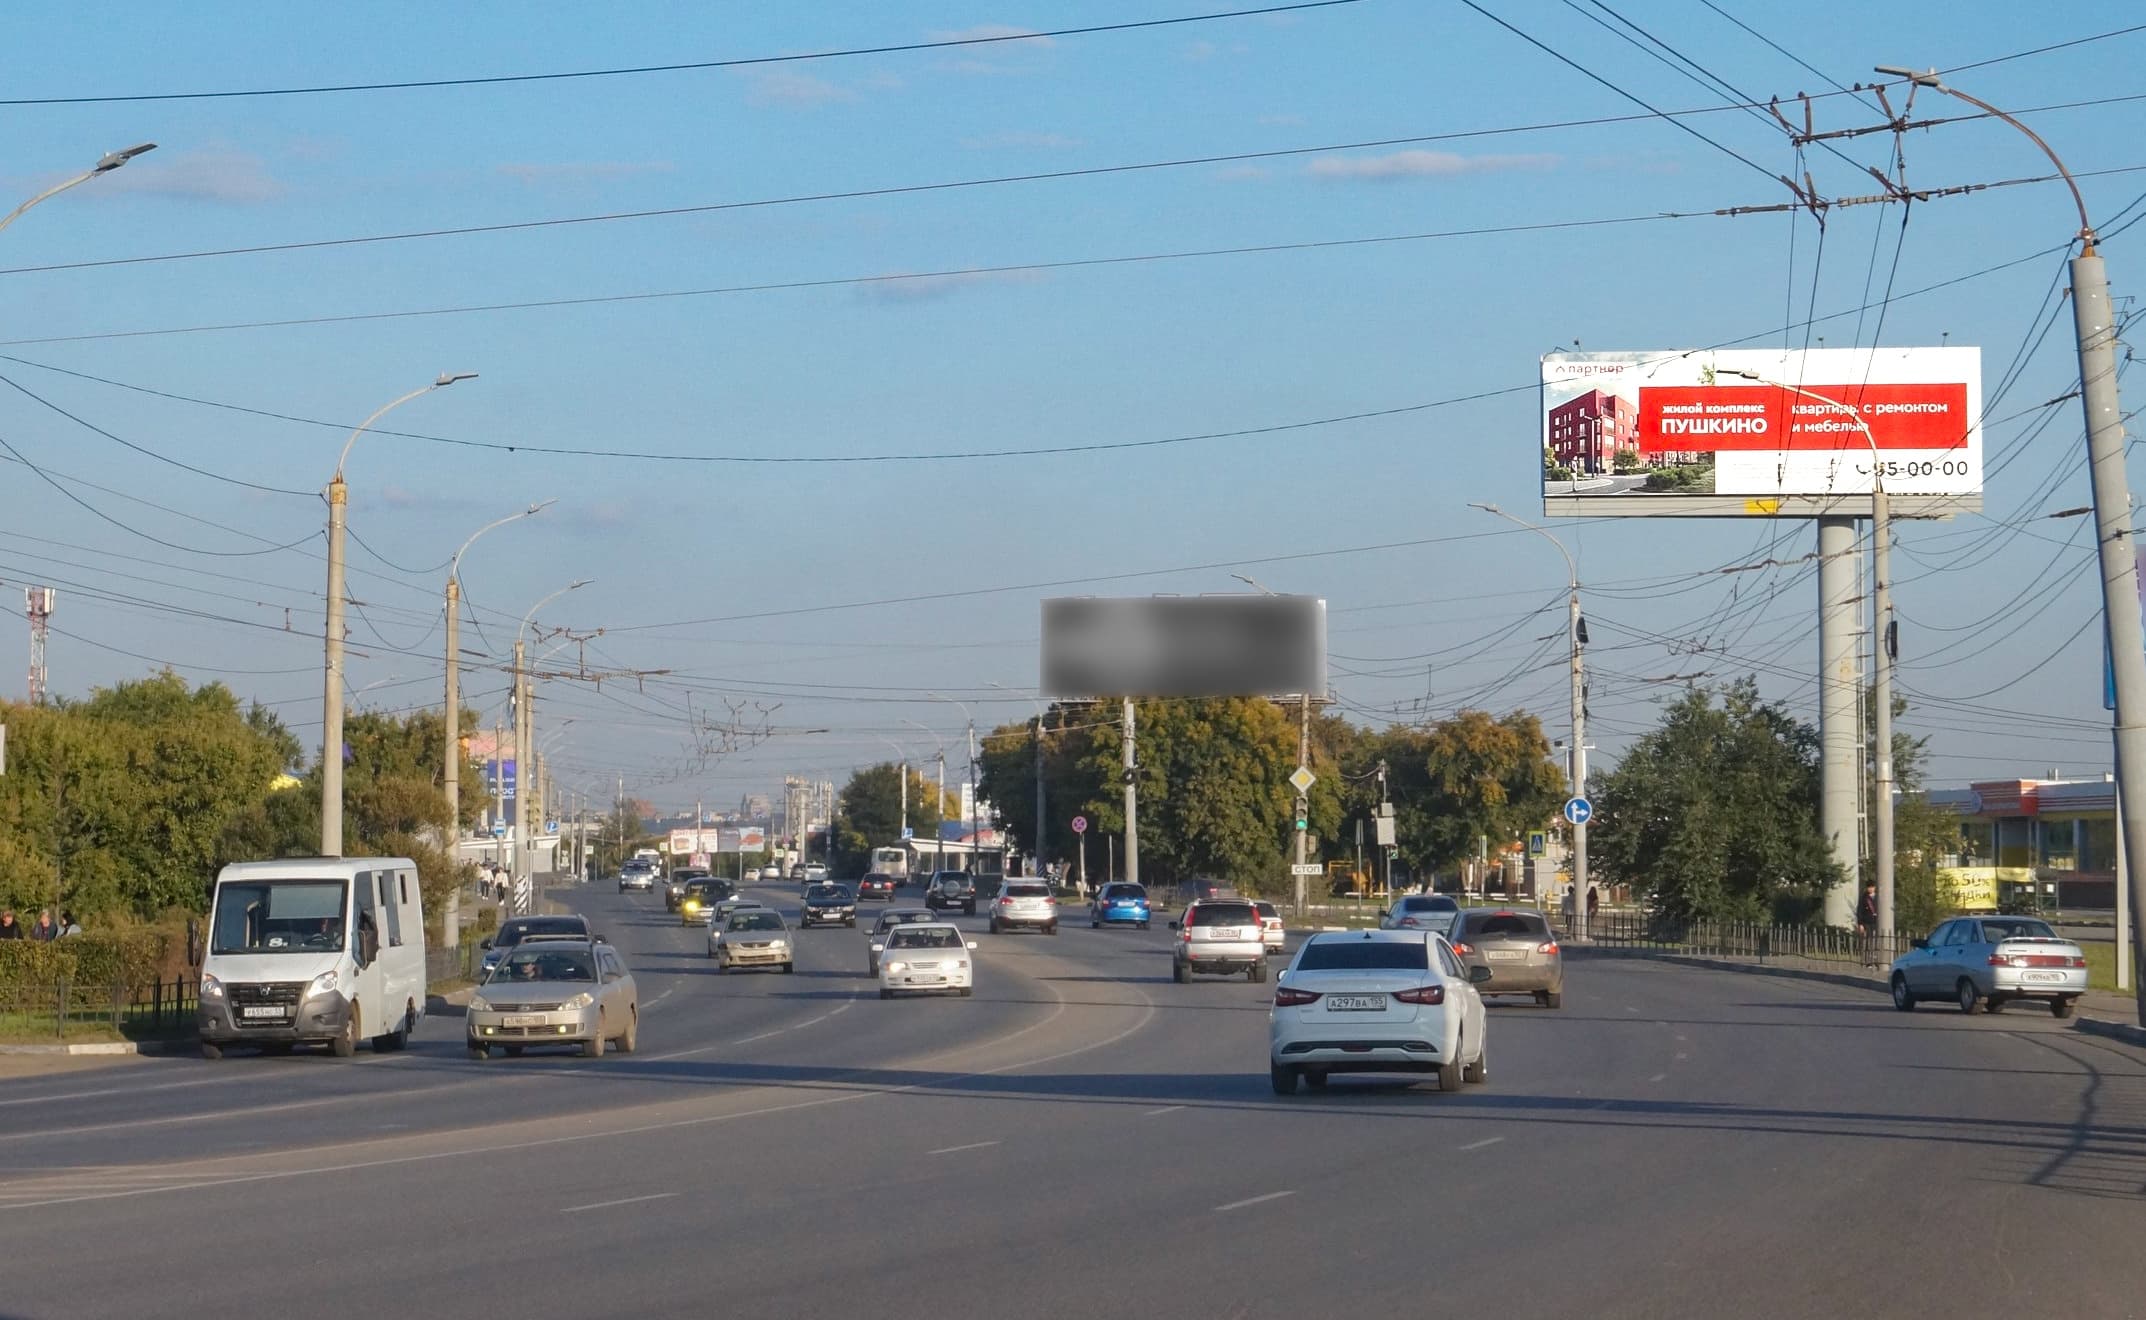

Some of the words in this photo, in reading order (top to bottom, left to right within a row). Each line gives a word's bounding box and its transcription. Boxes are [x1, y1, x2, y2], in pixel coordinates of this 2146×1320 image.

[1662, 402, 1703, 414] жилой
[1706, 404, 1765, 413] комплекс
[1863, 404, 1873, 413] с
[1875, 403, 1948, 415] ремонтом
[1661, 417, 1768, 434] ПУШКИНО
[1791, 423, 1801, 433] и
[1804, 419, 1869, 433] мебелью
